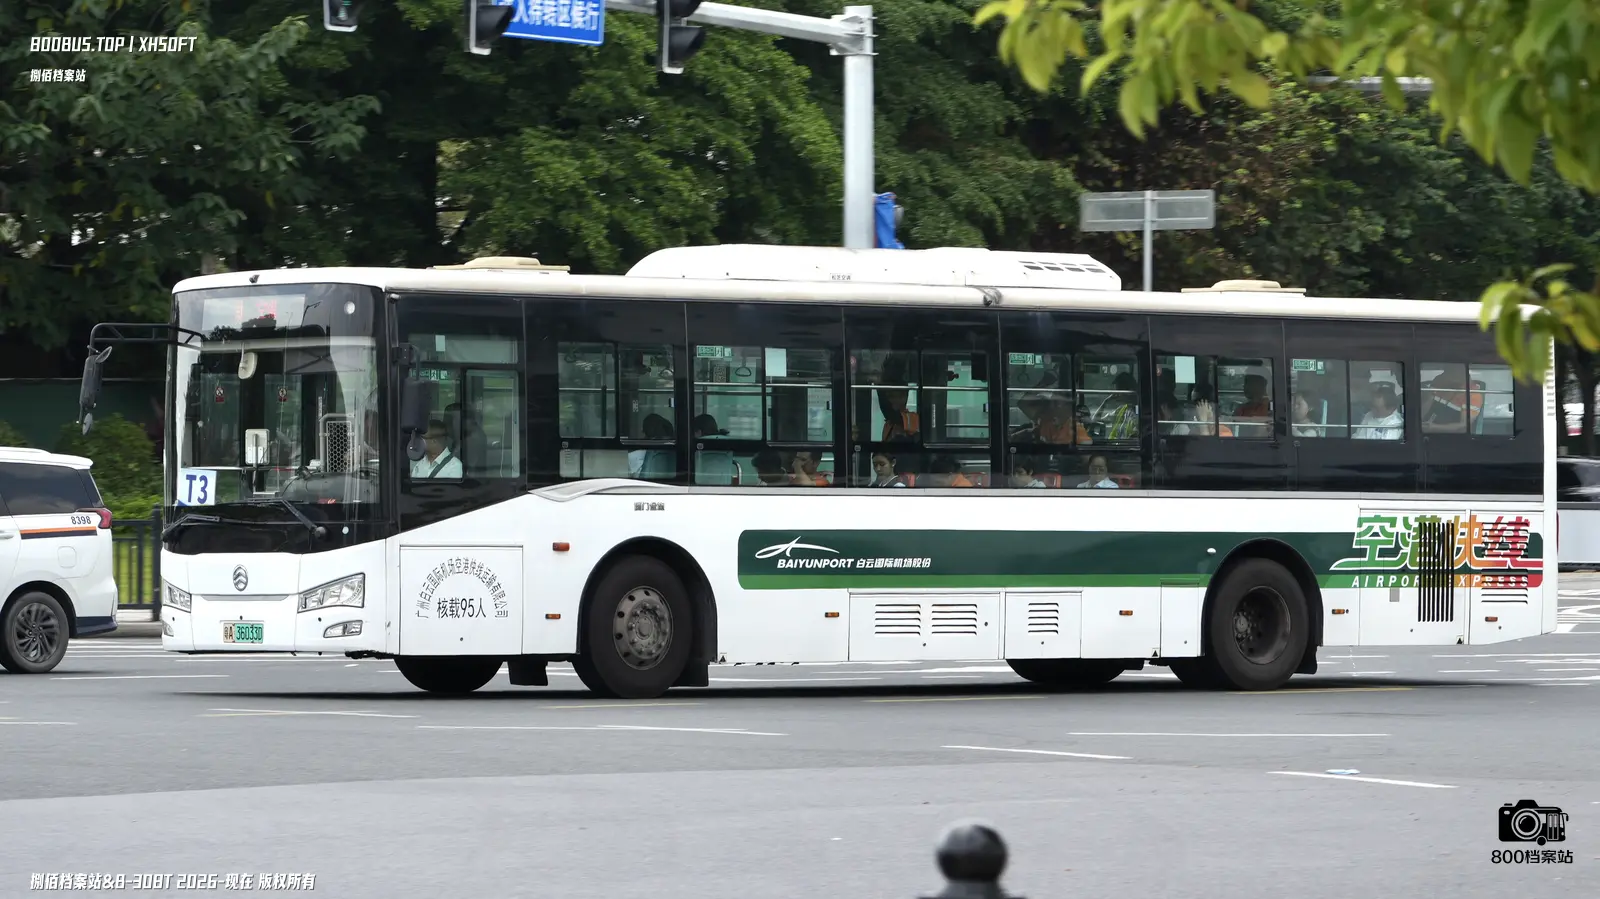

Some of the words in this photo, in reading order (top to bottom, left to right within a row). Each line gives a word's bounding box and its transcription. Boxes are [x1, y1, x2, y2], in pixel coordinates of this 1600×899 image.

[493, 0, 600, 31] 人待转区候行
[185, 474, 209, 504] T3
[70, 515, 92, 525] 8398
[777, 558, 854, 569] BAIYUNPORT
[856, 557, 932, 569] 白云国际机场股份
[437, 597, 487, 619] 核载95人
